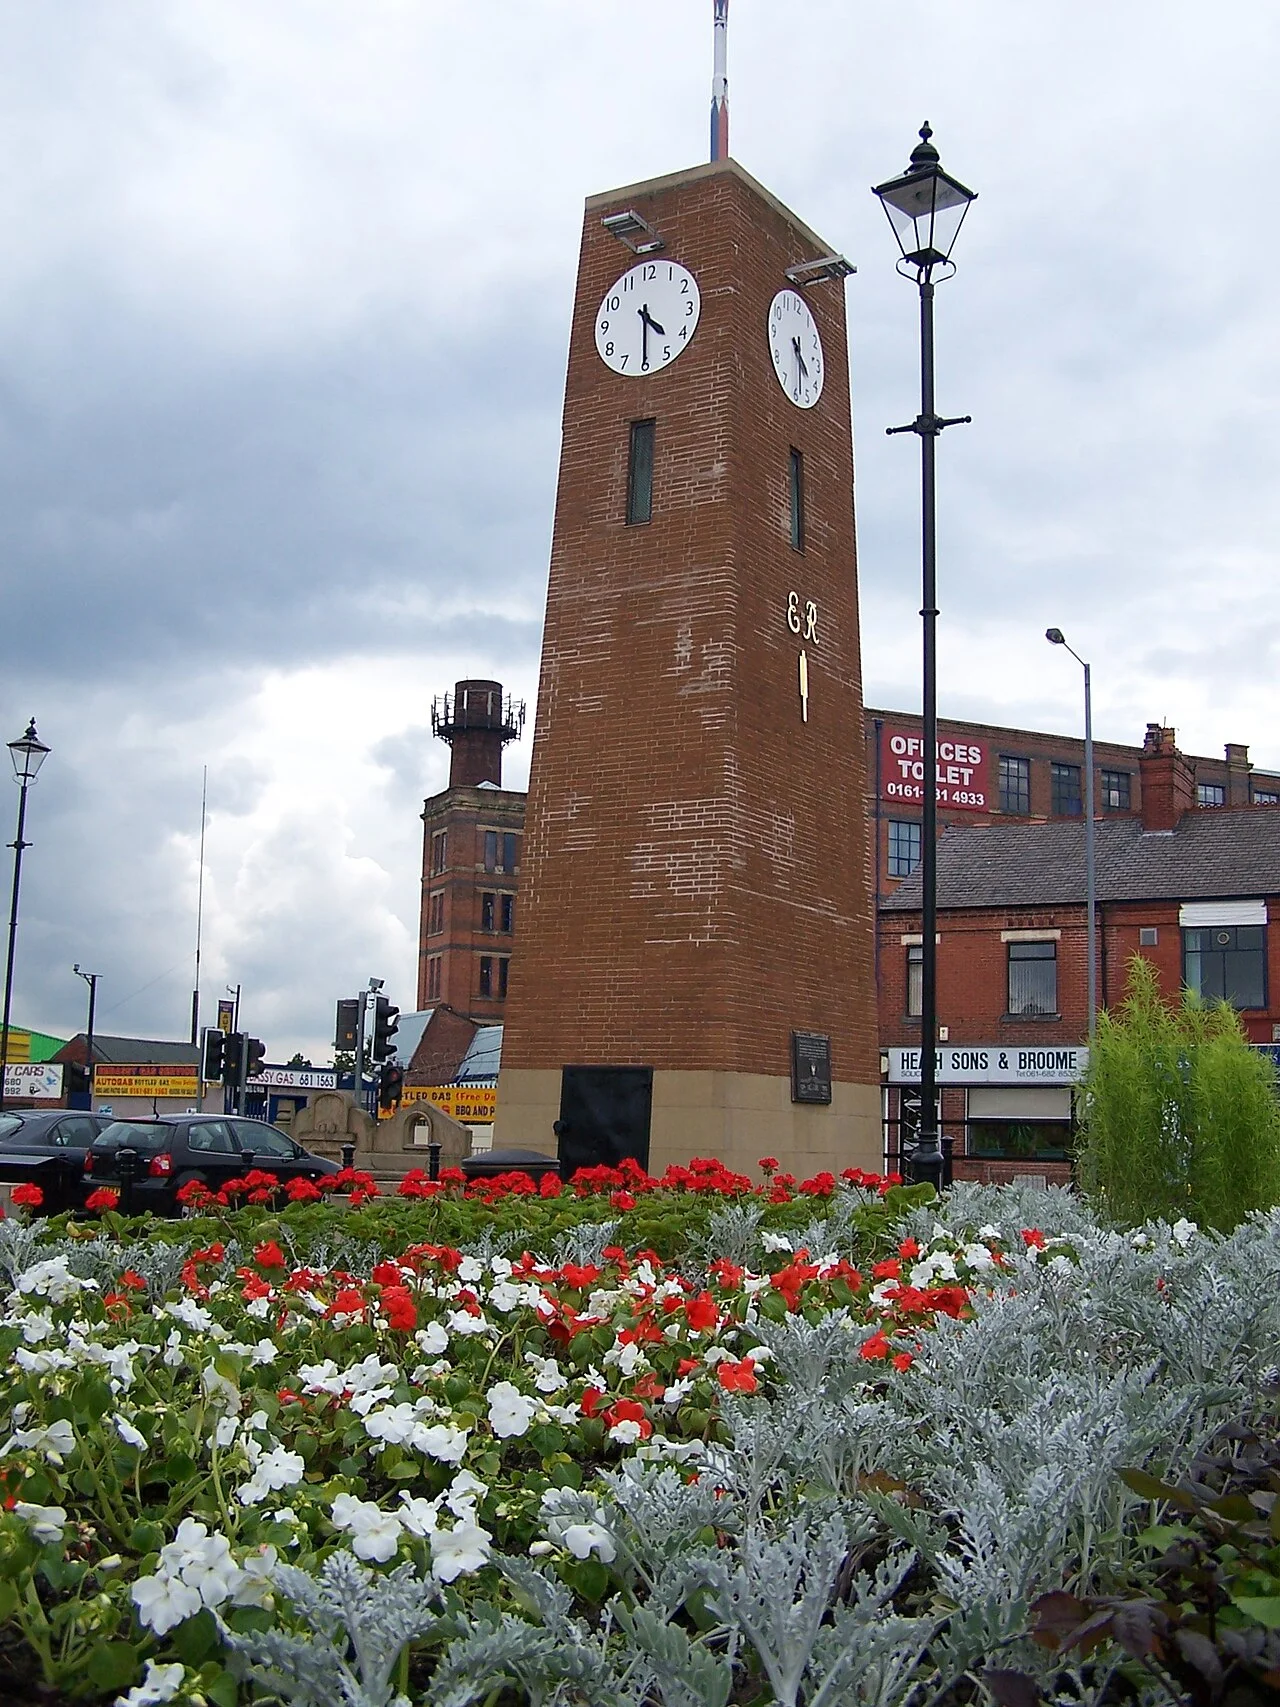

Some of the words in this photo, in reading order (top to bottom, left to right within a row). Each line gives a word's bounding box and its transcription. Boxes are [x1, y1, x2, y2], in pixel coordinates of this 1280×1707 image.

[643, 265, 656, 281] 12
[624, 276, 634, 292] 11
[680, 279, 689, 294] 2
[606, 296, 620, 312] 10
[685, 301, 694, 316] 3
[783, 294, 790, 311] 11
[794, 297, 801, 315] 12
[773, 303, 782, 321] 10
[600, 320, 609, 335] 9
[678, 325, 688, 340] 4
[771, 324, 777, 338] 9
[605, 341, 614, 356] 8
[813, 334, 818, 350] 2
[662, 345, 671, 361] 5
[774, 349, 780, 364] 8
[620, 354, 629, 370] 7
[816, 359, 821, 374] 3
[782, 371, 788, 386] 7
[793, 387, 799, 402] 6
[812, 381, 818, 394] 4
[805, 389, 810, 404] 5
[898, 760, 924, 780] TO
[935, 764, 973, 786] LET
[952, 790, 985, 806] 4933
[951, 1052, 988, 1070] SONS
[998, 1052, 1009, 1069] &
[1019, 1052, 1077, 1070] BROOME
[15, 1066, 44, 1076] CARS
[276, 1072, 294, 1084] GAS
[300, 1074, 313, 1085] 681
[317, 1075, 334, 1087] 1563
[432, 1092, 451, 1101] GAS
[473, 1105, 488, 1116] AND
